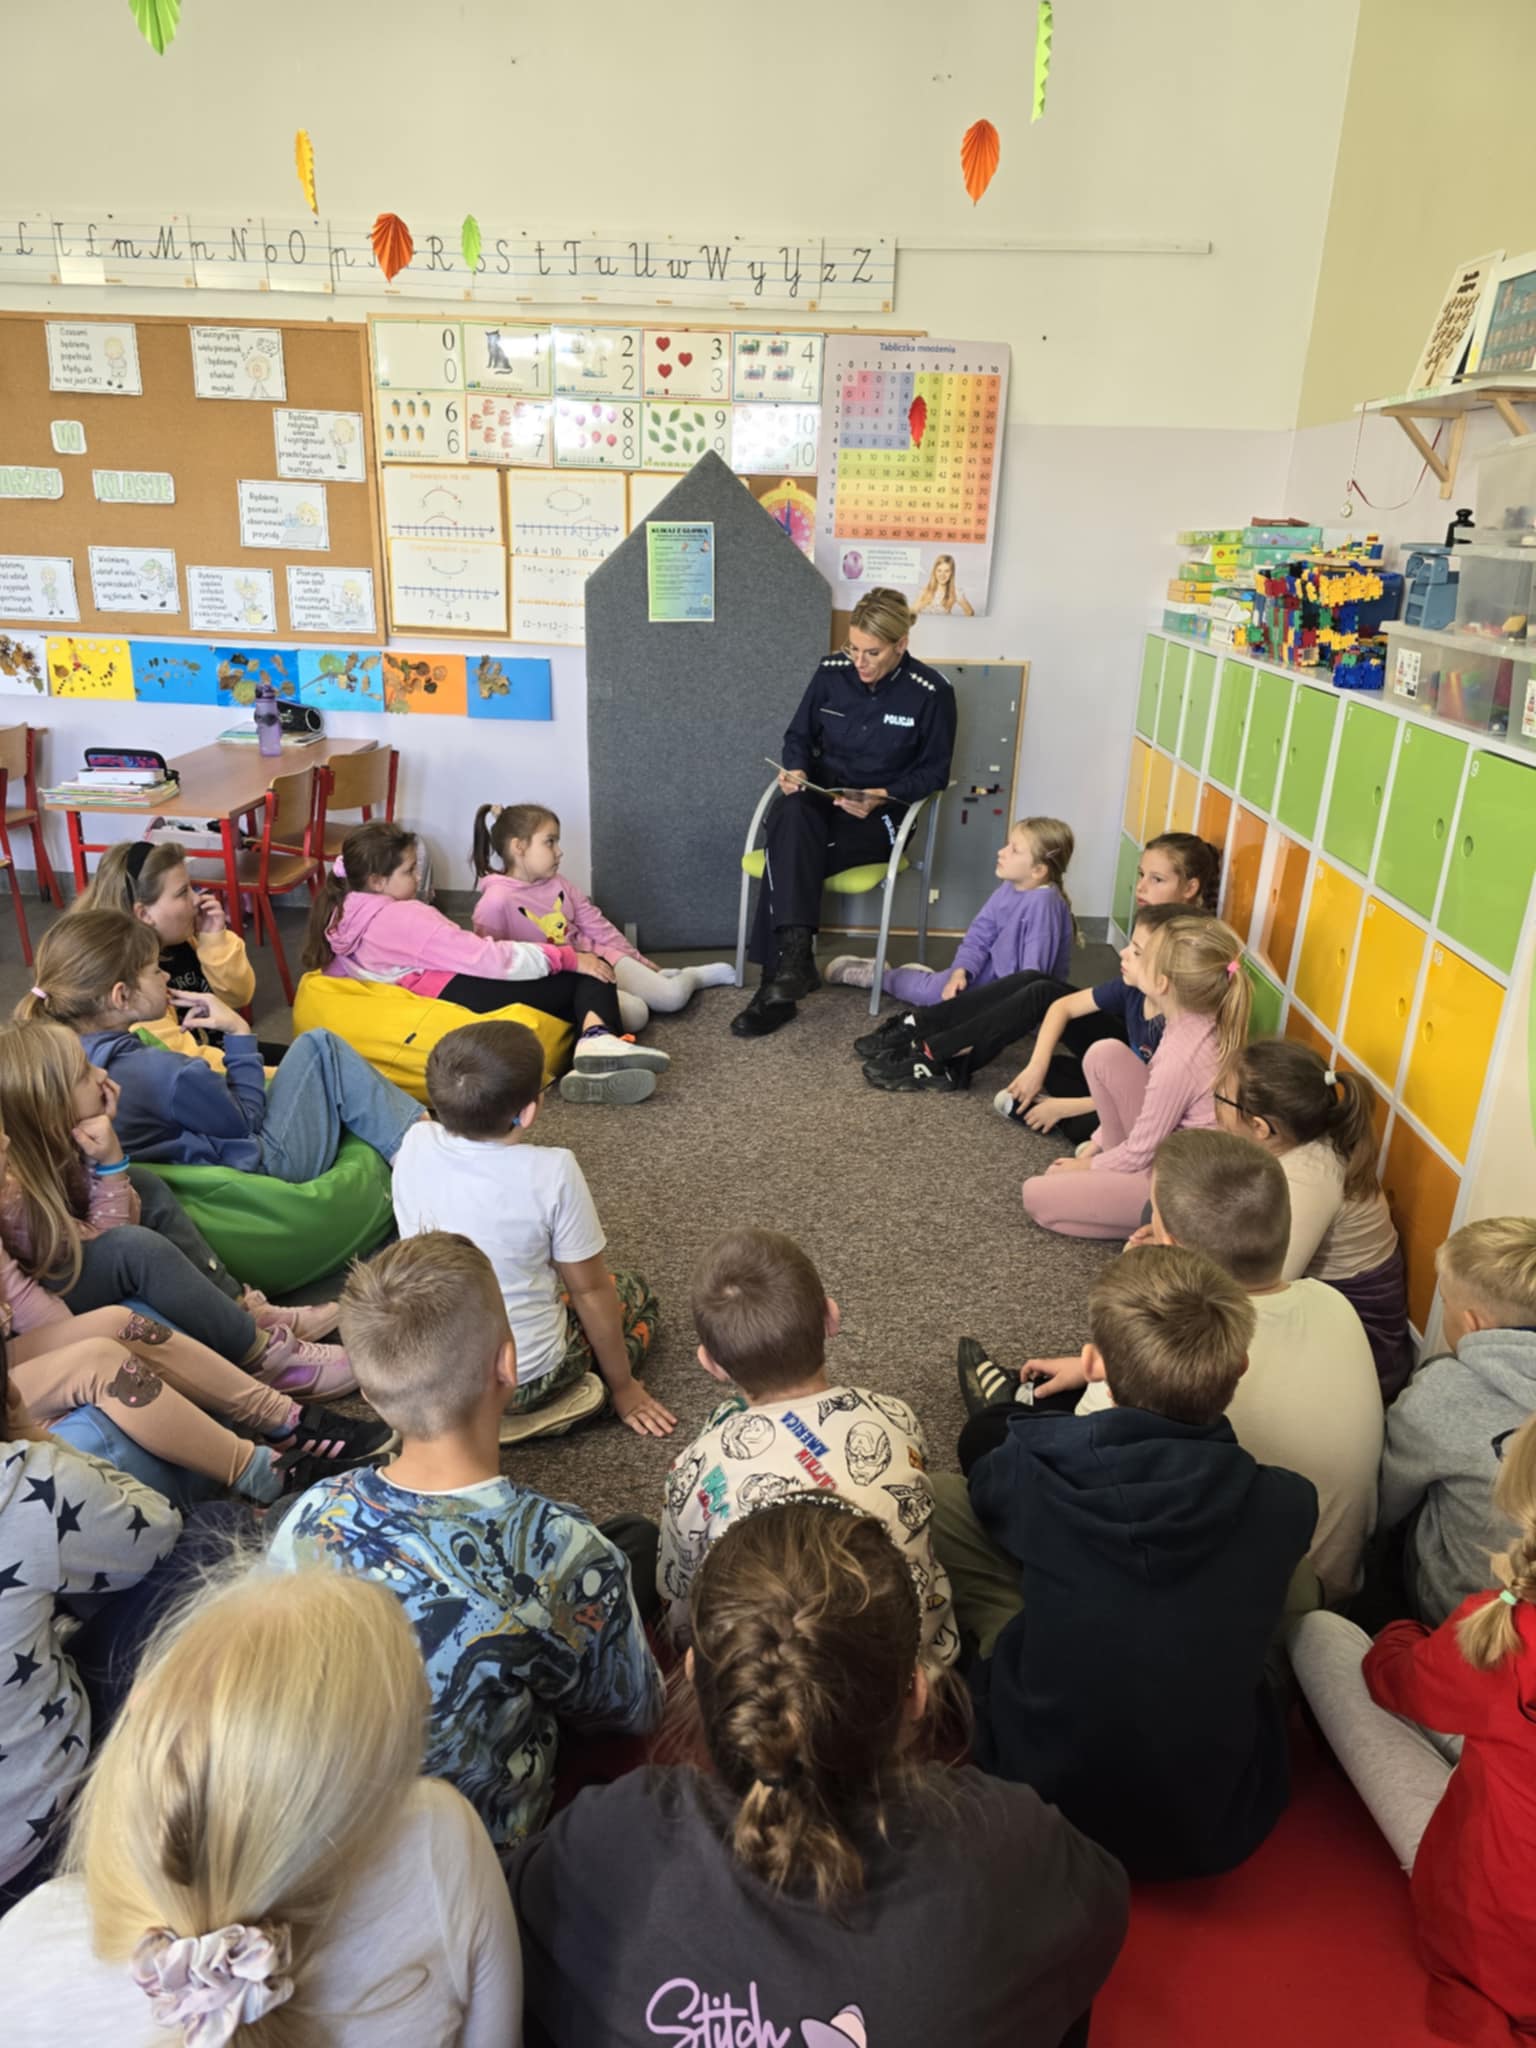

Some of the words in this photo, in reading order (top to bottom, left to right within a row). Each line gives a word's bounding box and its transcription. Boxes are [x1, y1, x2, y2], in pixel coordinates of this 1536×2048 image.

[112, 238, 142, 258] m
[150, 225, 182, 259] M
[192, 239, 215, 261] n
[228, 228, 249, 263] N
[289, 230, 306, 265] O
[426, 236, 453, 271] R
[496, 239, 510, 274] S
[535, 241, 551, 276] t
[563, 241, 582, 276] T
[594, 256, 619, 276] u
[629, 242, 656, 278] U
[667, 259, 691, 280] w
[700, 245, 732, 282] W
[748, 259, 766, 296] y
[822, 262, 837, 282] z
[853, 247, 873, 283] Z
[442, 329, 455, 351] 0
[533, 333, 541, 355] 1
[621, 336, 634, 358] 2
[711, 338, 723, 361] 3
[802, 339, 815, 362] 4
[880, 342, 915, 352] Tabliczka
[444, 358, 457, 383] 0
[532, 363, 540, 387] 1
[622, 364, 635, 390] 2
[710, 367, 724, 393] 3
[801, 369, 814, 395] 4
[445, 401, 458, 423] 6
[622, 406, 635, 429] 8
[714, 409, 726, 430] 9
[447, 428, 460, 454] 6
[622, 434, 635, 459] 8
[792, 441, 816, 467] 10
[779, 1411, 830, 1458] AMERICA
[794, 1447, 838, 1492] CAPTAIN
[645, 1977, 791, 2048] Stitch
